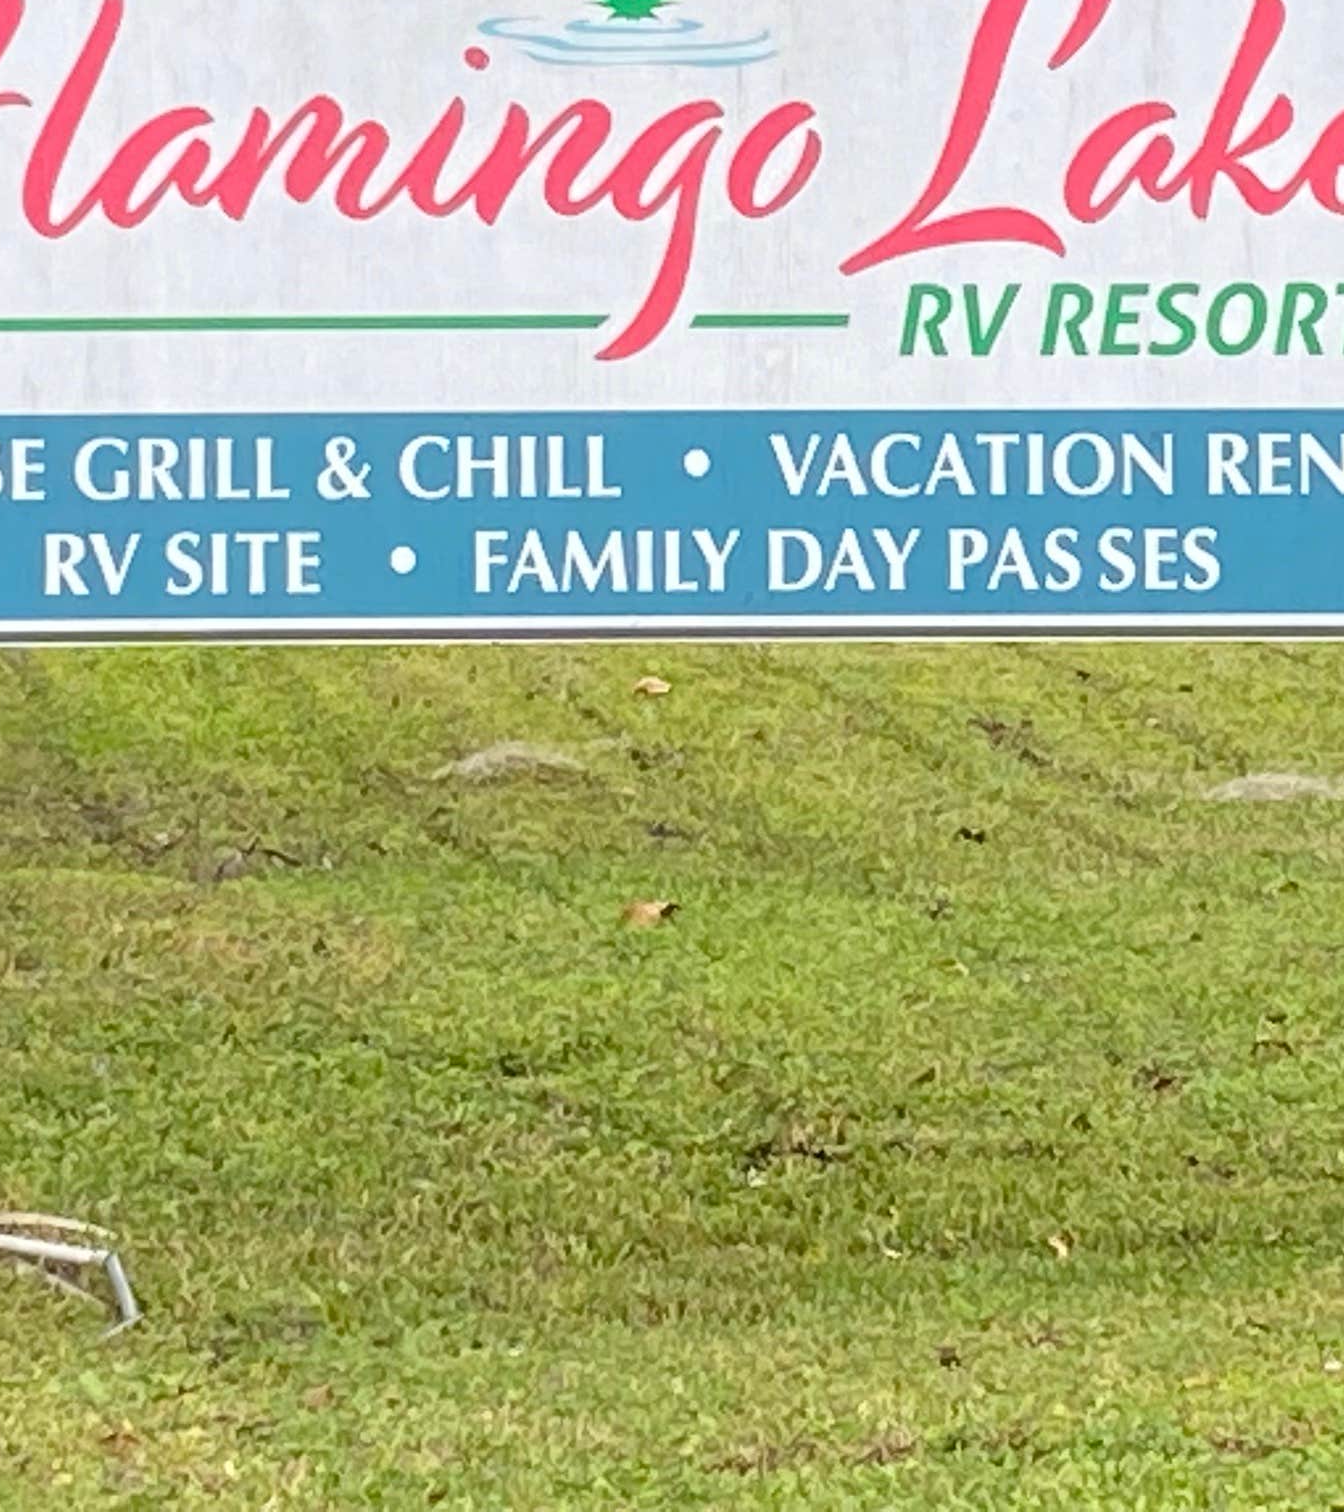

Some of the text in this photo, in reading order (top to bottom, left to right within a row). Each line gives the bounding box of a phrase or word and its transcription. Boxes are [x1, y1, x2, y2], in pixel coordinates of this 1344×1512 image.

[899, 282, 1018, 356] RV
[73, 436, 291, 501] GRILL
[316, 435, 372, 500] &
[398, 434, 623, 500] CHILL
[768, 431, 1174, 497] VACATION
[43, 526, 1221, 596] RV SITE FAMILY DAY PASSES
